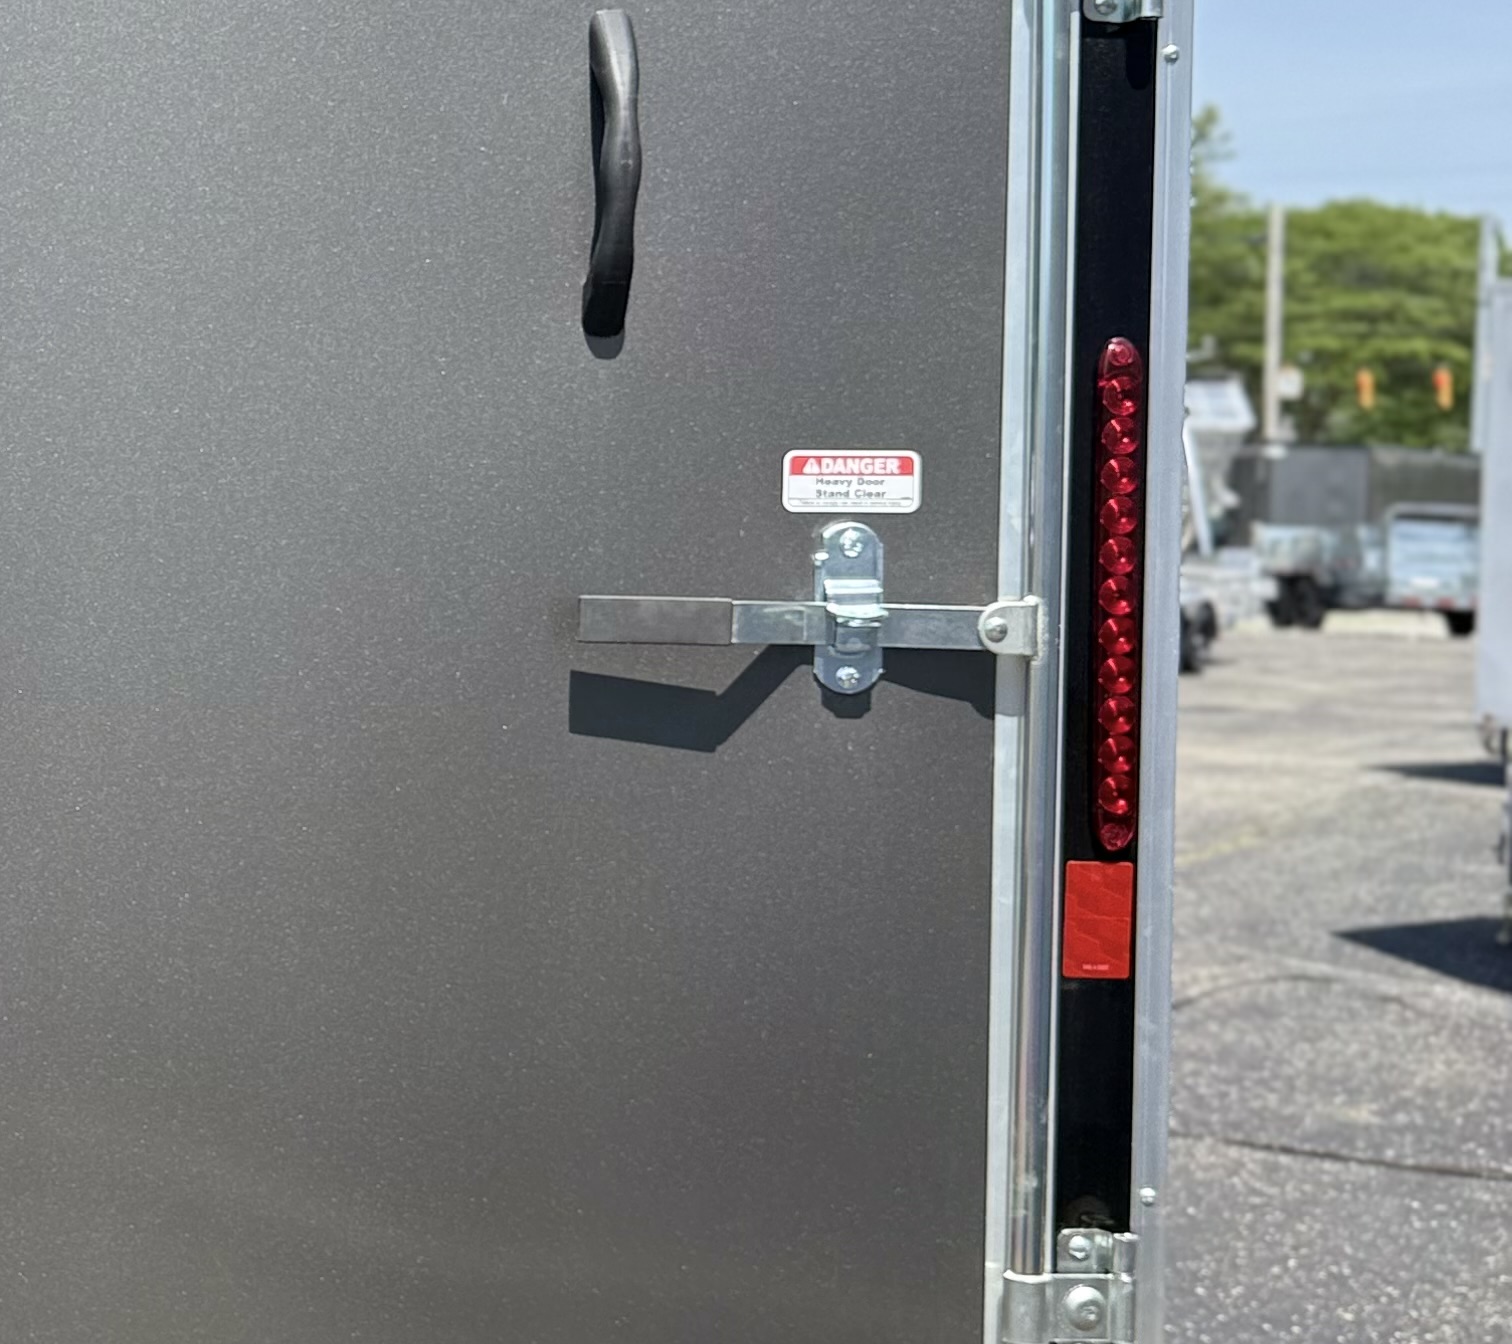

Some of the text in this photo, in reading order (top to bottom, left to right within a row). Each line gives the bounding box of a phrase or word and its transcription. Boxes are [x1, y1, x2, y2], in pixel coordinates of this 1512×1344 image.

[820, 457, 901, 475] DANGER
[815, 478, 885, 488] Heavy Door
[815, 489, 887, 498] Stand Clear
